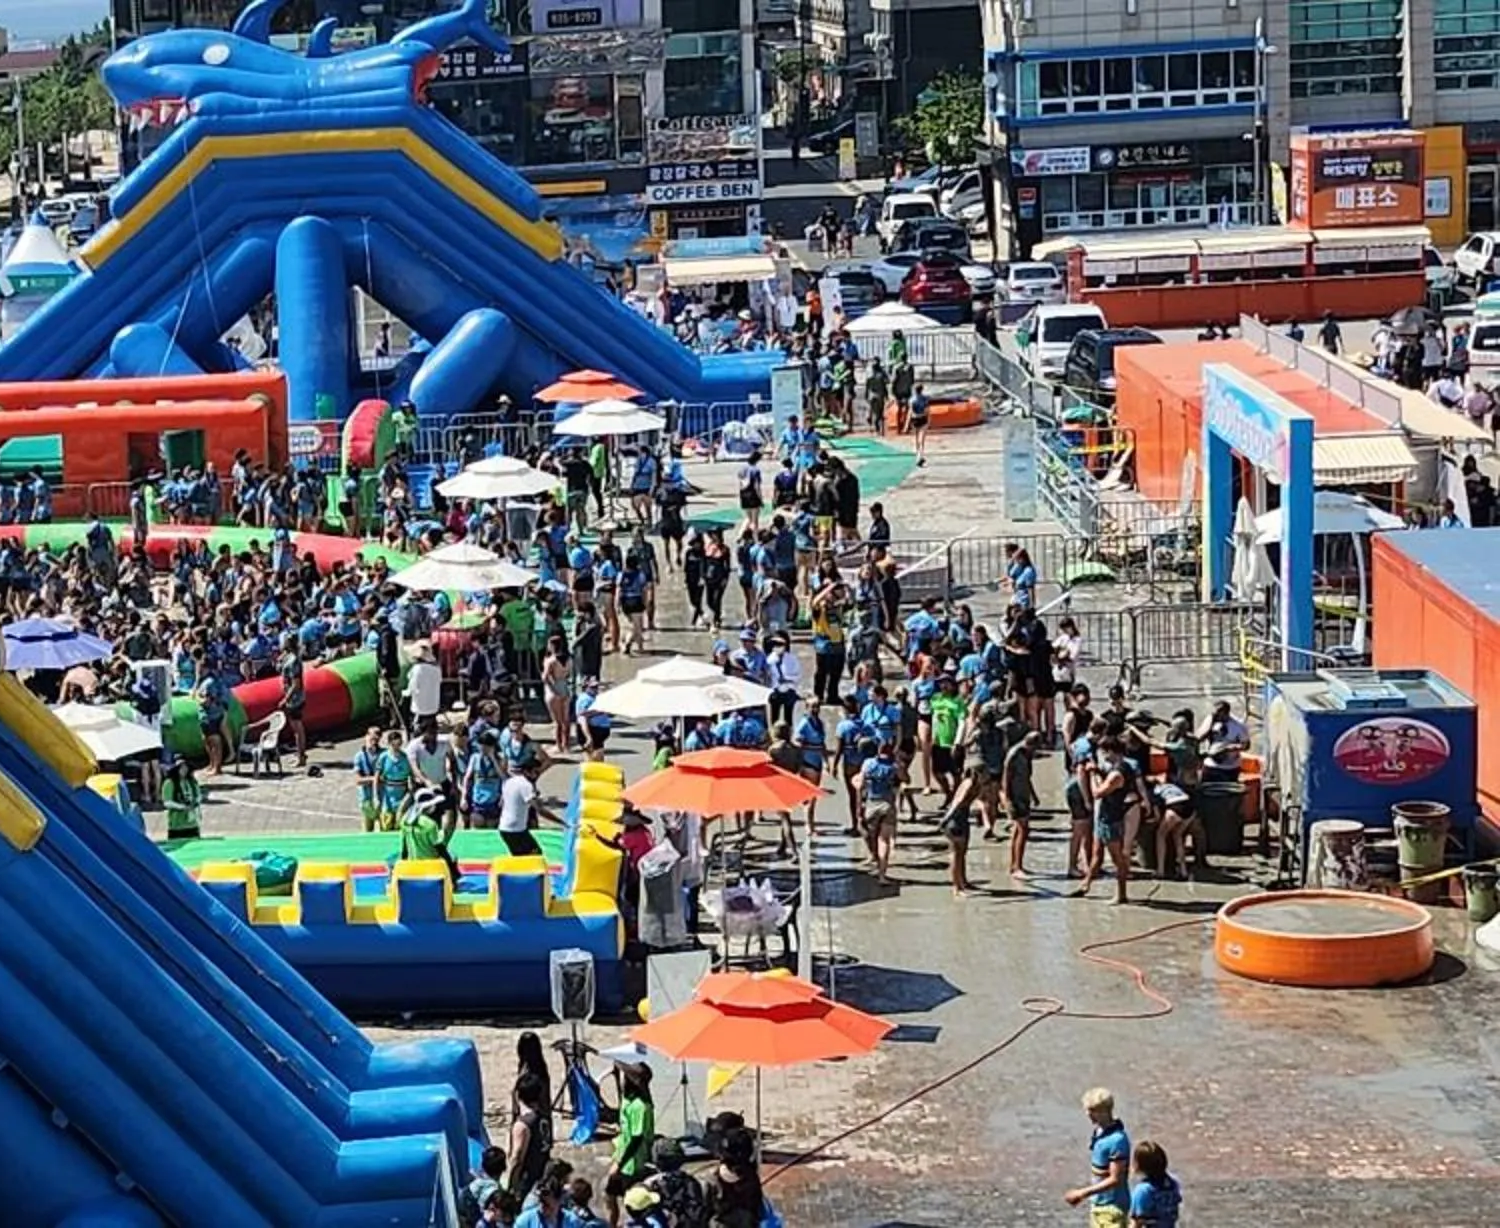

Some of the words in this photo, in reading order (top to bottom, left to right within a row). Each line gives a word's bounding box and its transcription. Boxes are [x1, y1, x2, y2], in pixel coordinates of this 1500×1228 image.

[652, 186, 717, 200] COFFEE
[721, 184, 753, 197] BEN
[1335, 186, 1399, 209] 매표소
